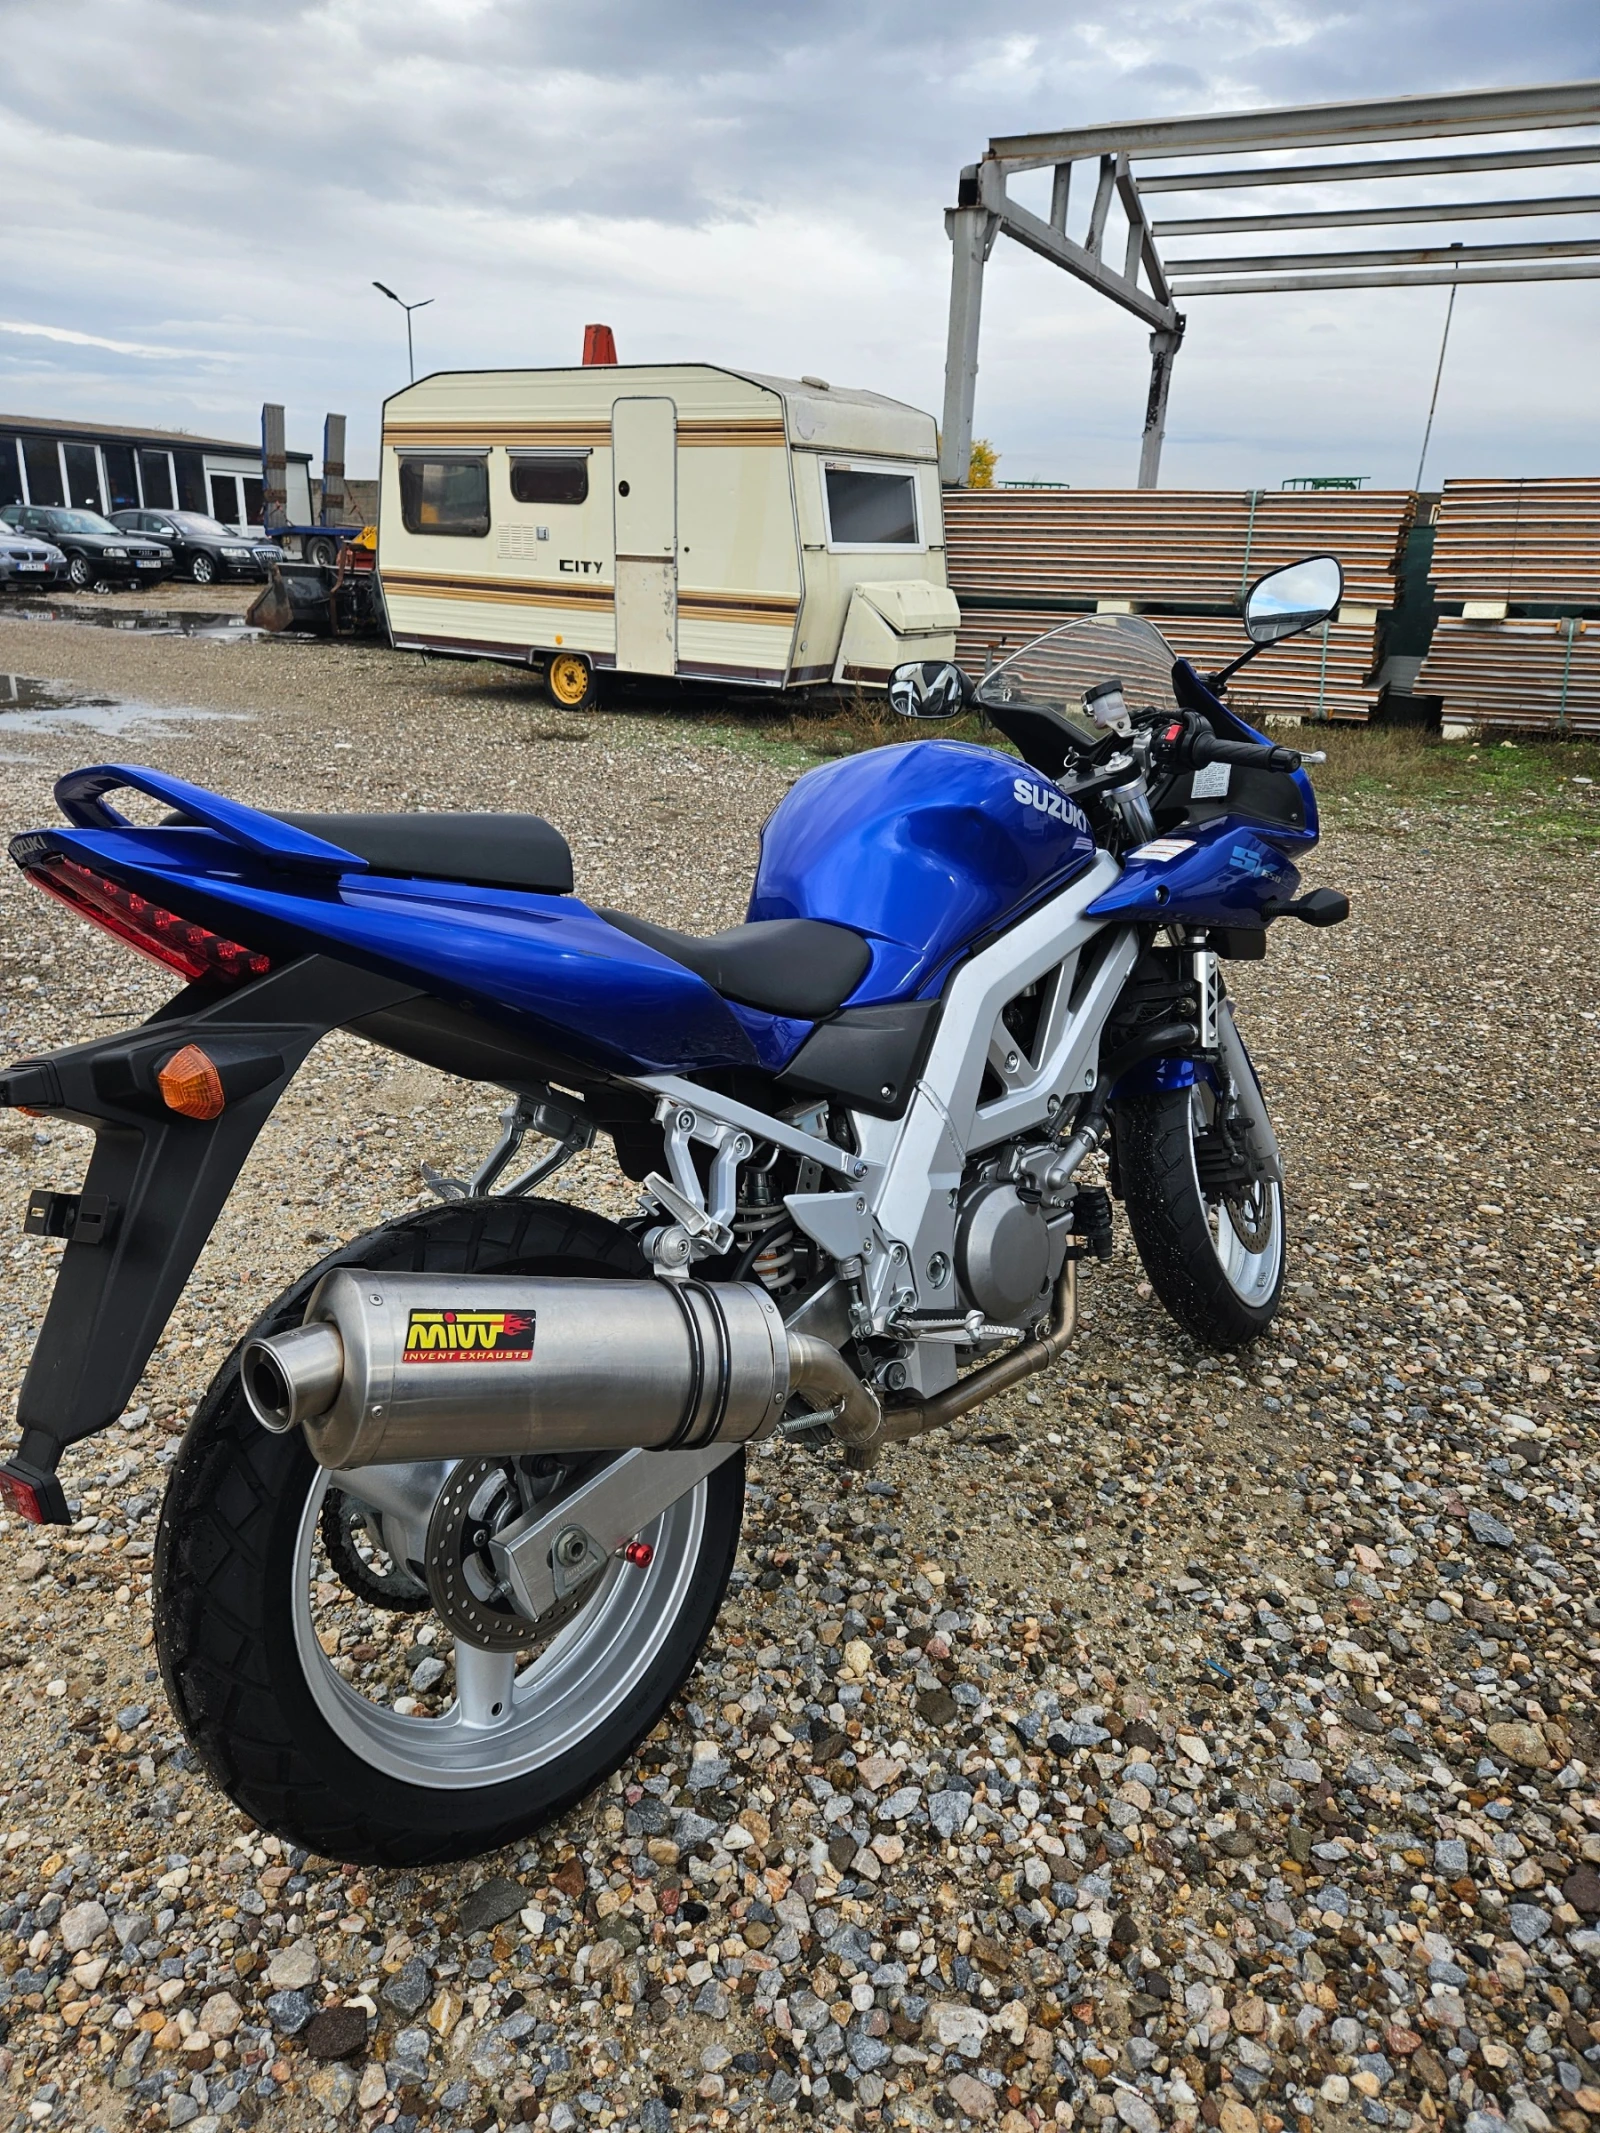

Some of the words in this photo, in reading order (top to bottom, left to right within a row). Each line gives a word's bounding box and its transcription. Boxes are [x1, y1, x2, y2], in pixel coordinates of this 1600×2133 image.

[559, 559, 603, 574] CITY
[1013, 778, 1087, 833] SUZUKI
[403, 1352, 455, 1362] INVENT
[460, 1351, 530, 1361] EXHAUSTS
